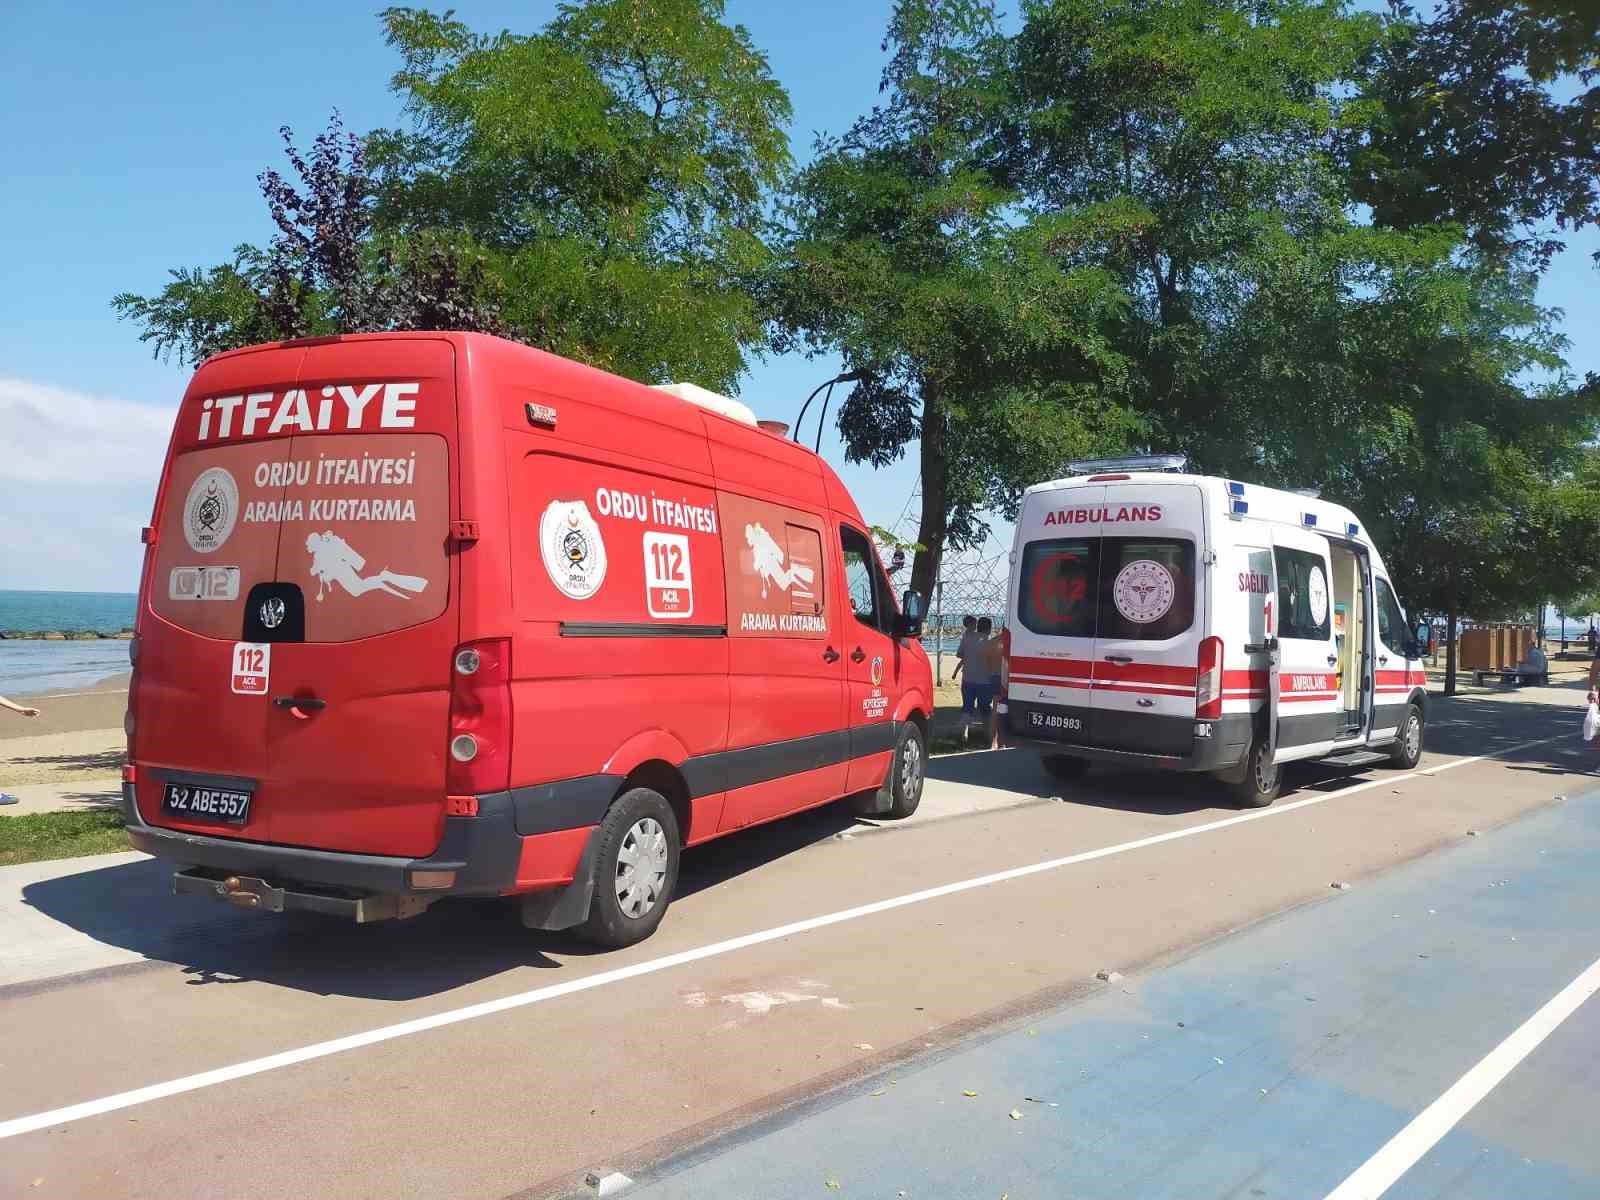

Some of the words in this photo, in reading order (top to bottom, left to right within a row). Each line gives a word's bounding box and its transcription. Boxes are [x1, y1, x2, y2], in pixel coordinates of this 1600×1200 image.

[255, 461, 310, 488] ORDU
[316, 451, 416, 487] İTFAİYESİ
[243, 501, 304, 522] ARAMA
[309, 499, 416, 522] KURTARMA
[595, 487, 648, 522] ORDU
[652, 490, 717, 534] İTFAİYESİ
[1044, 506, 1162, 526] AMBULANS
[650, 542, 685, 581] 112
[741, 613, 777, 631] ARAMA
[779, 614, 827, 632] KURTARMA
[239, 648, 265, 672] 112
[1032, 714, 1043, 726] 52
[169, 787, 189, 809] 52
[190, 789, 249, 816] ABE557
